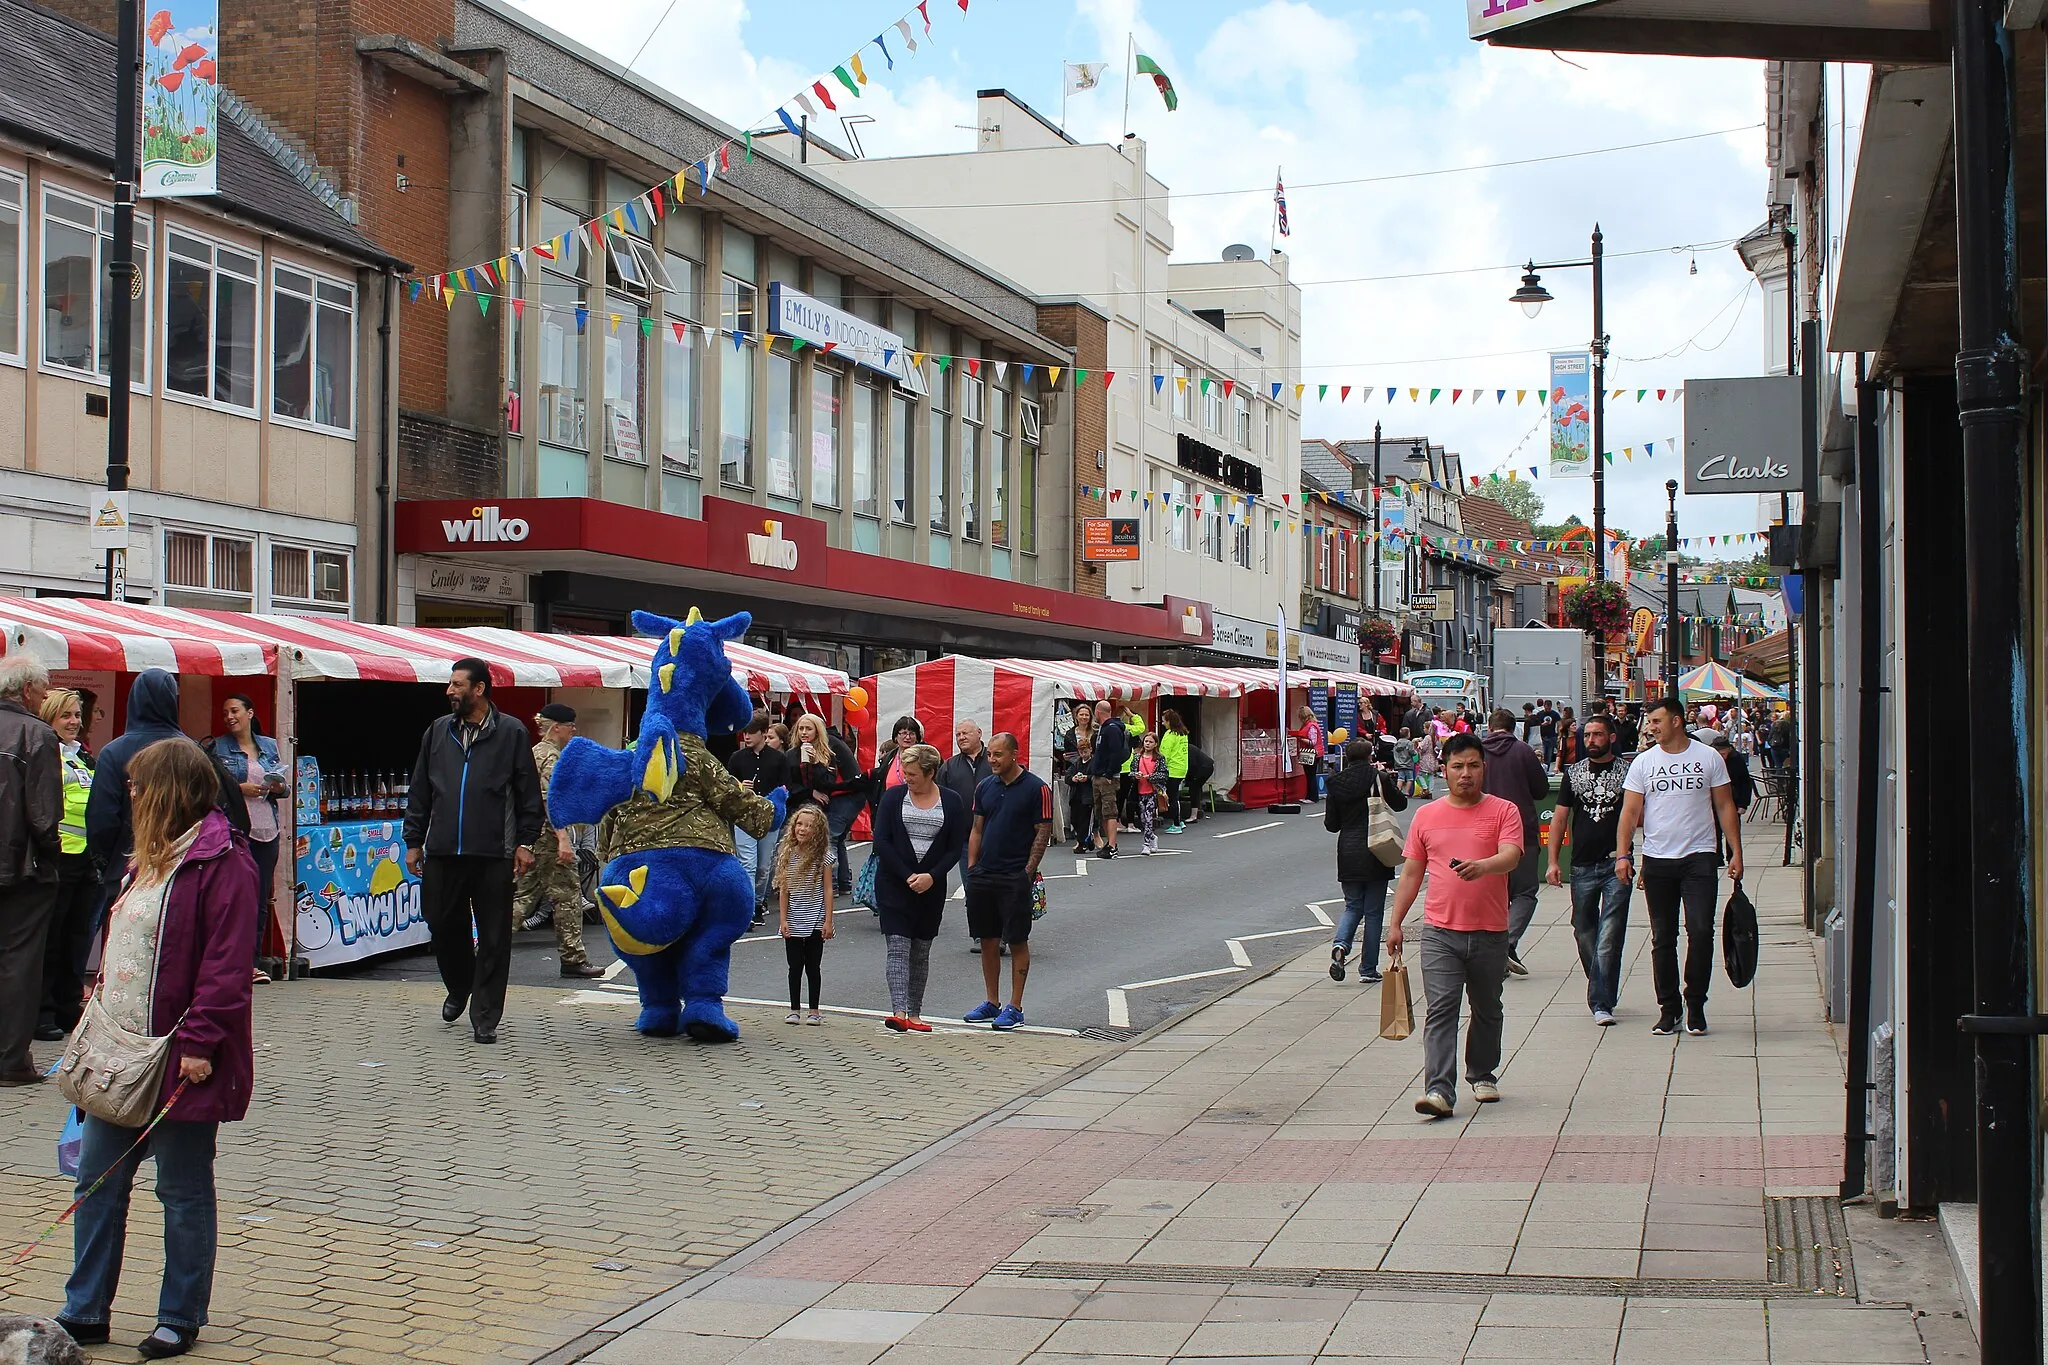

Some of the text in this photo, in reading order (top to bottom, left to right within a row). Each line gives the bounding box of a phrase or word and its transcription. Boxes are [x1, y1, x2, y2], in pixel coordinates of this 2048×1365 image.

[785, 299, 831, 337] EMILY'S
[834, 319, 870, 354] INDOOR
[1697, 455, 1789, 481] Clarks
[441, 506, 529, 542] wilko
[431, 569, 465, 590] Emily's
[1216, 623, 1234, 644] Screen
[1234, 628, 1254, 648] Cinema
[1414, 678, 1461, 687] Mister Softee
[1651, 777, 1704, 792] JONES
[368, 829, 382, 837] SMALL
[376, 847, 388, 855] LARGE
